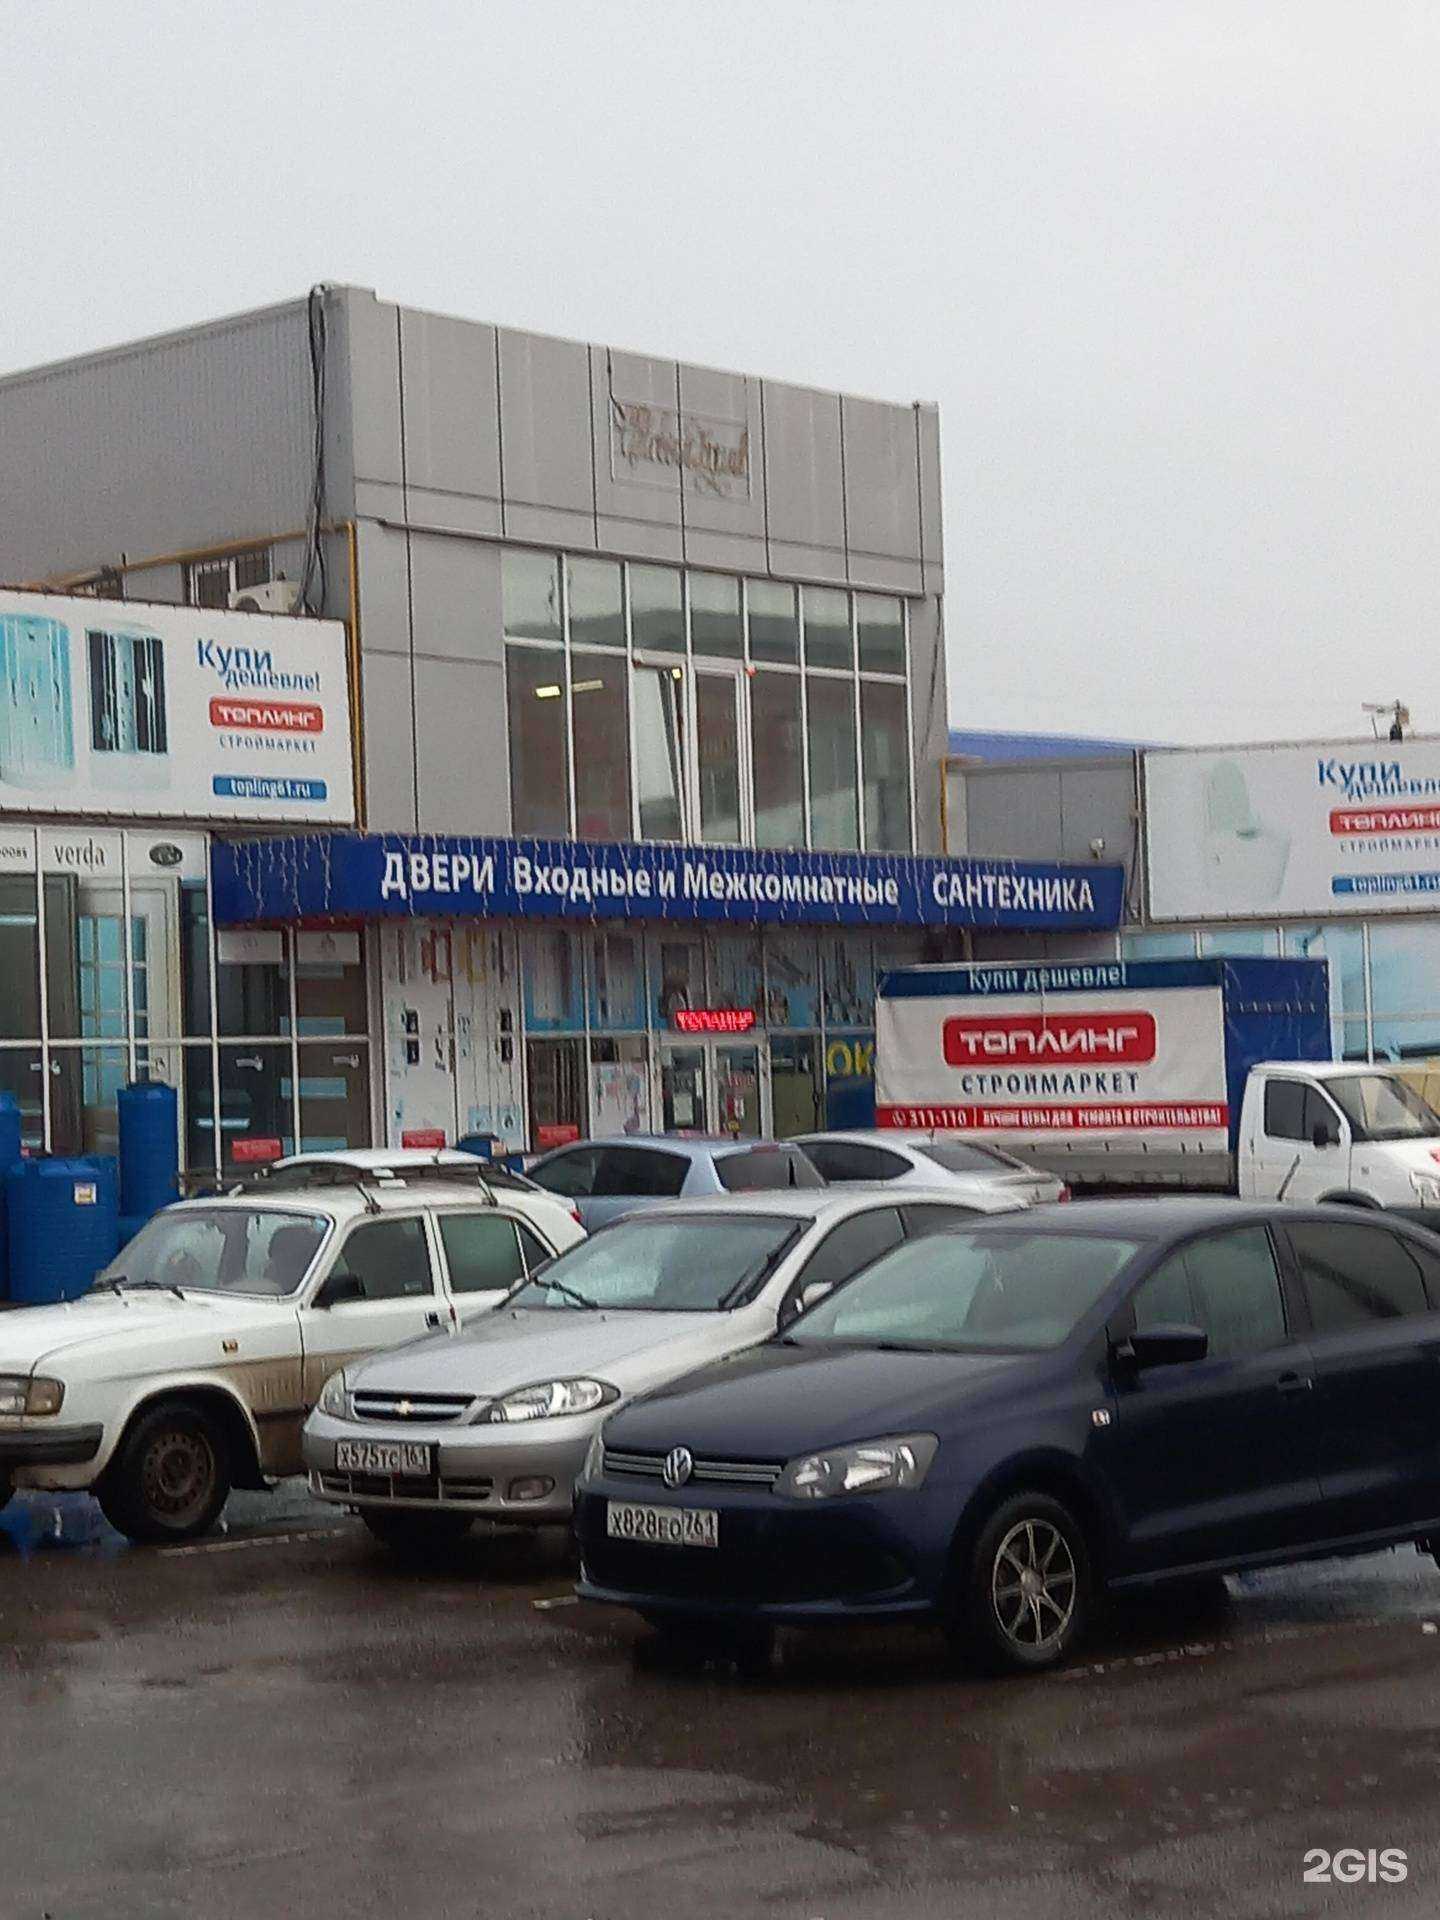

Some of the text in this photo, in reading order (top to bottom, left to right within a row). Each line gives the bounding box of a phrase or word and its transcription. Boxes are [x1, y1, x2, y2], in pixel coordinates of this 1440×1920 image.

[197, 638, 273, 677] Купи
[225, 668, 321, 692] дешевле!
[217, 704, 316, 728] ТОПЛИНГ
[1317, 758, 1400, 795] Купи
[381, 852, 1095, 913] ДВЕРИ Входные и Межкомнатные САНТЕХНИКА
[969, 962, 1127, 994] Купи дешевле!
[960, 1026, 1139, 1057] ТОПЛИНГ
[961, 1070, 1140, 1096] СТРОЙМАРКЕТ
